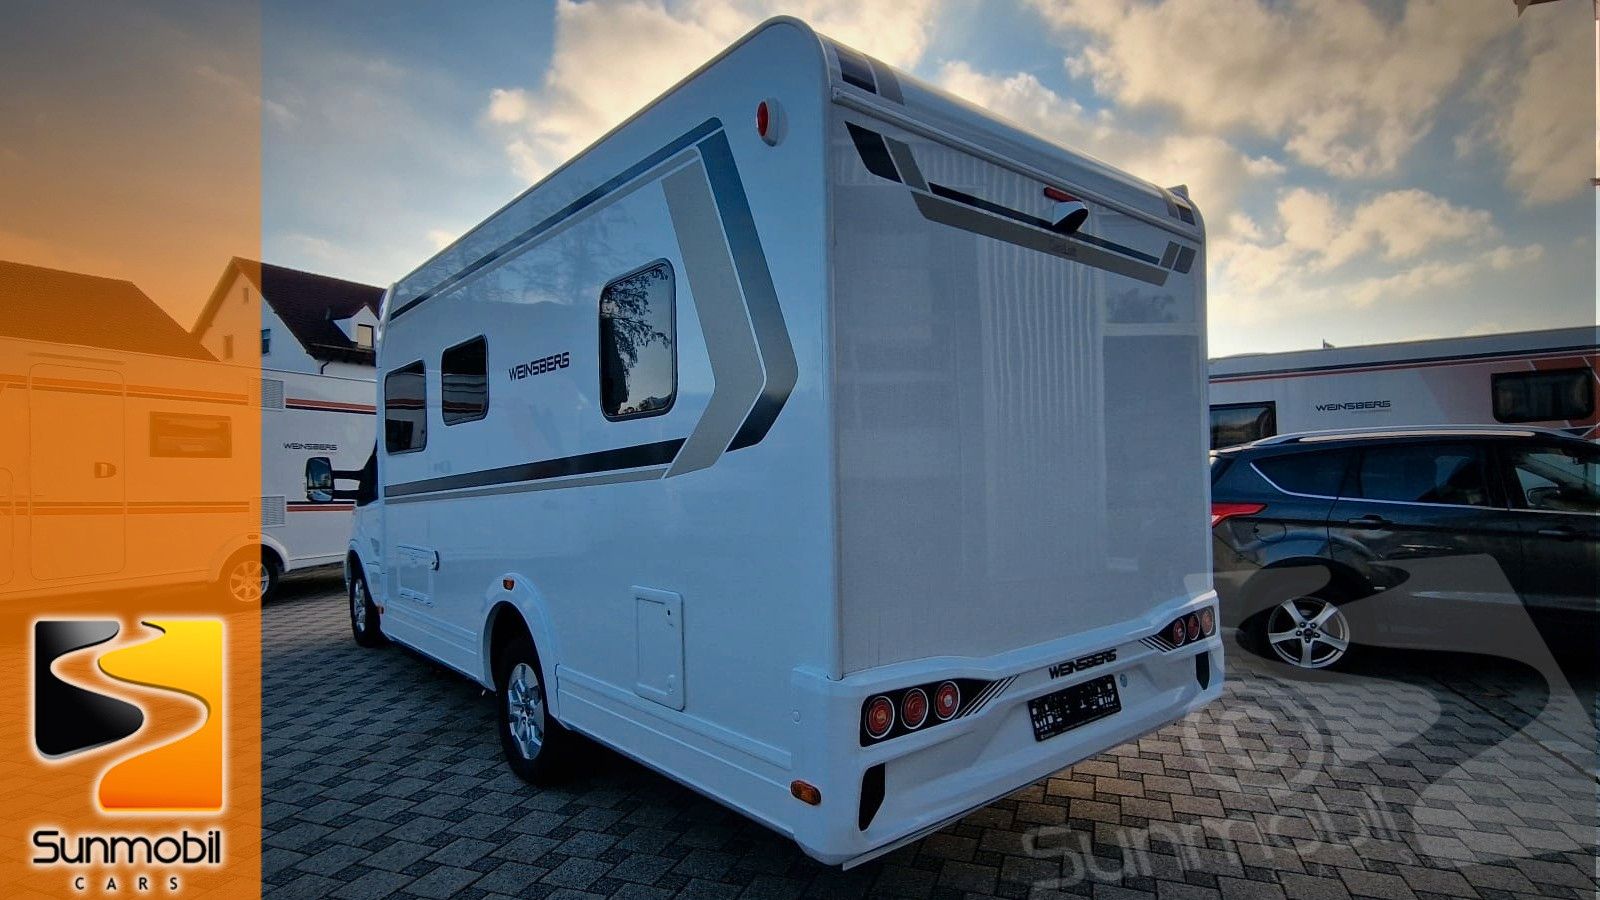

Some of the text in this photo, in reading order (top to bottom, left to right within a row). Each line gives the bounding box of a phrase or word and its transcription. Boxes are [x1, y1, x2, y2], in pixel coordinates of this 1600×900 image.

[508, 351, 570, 382] WEINSBERG
[1315, 400, 1391, 412] WEINSBERG
[1048, 648, 1117, 680] WEINSBERG
